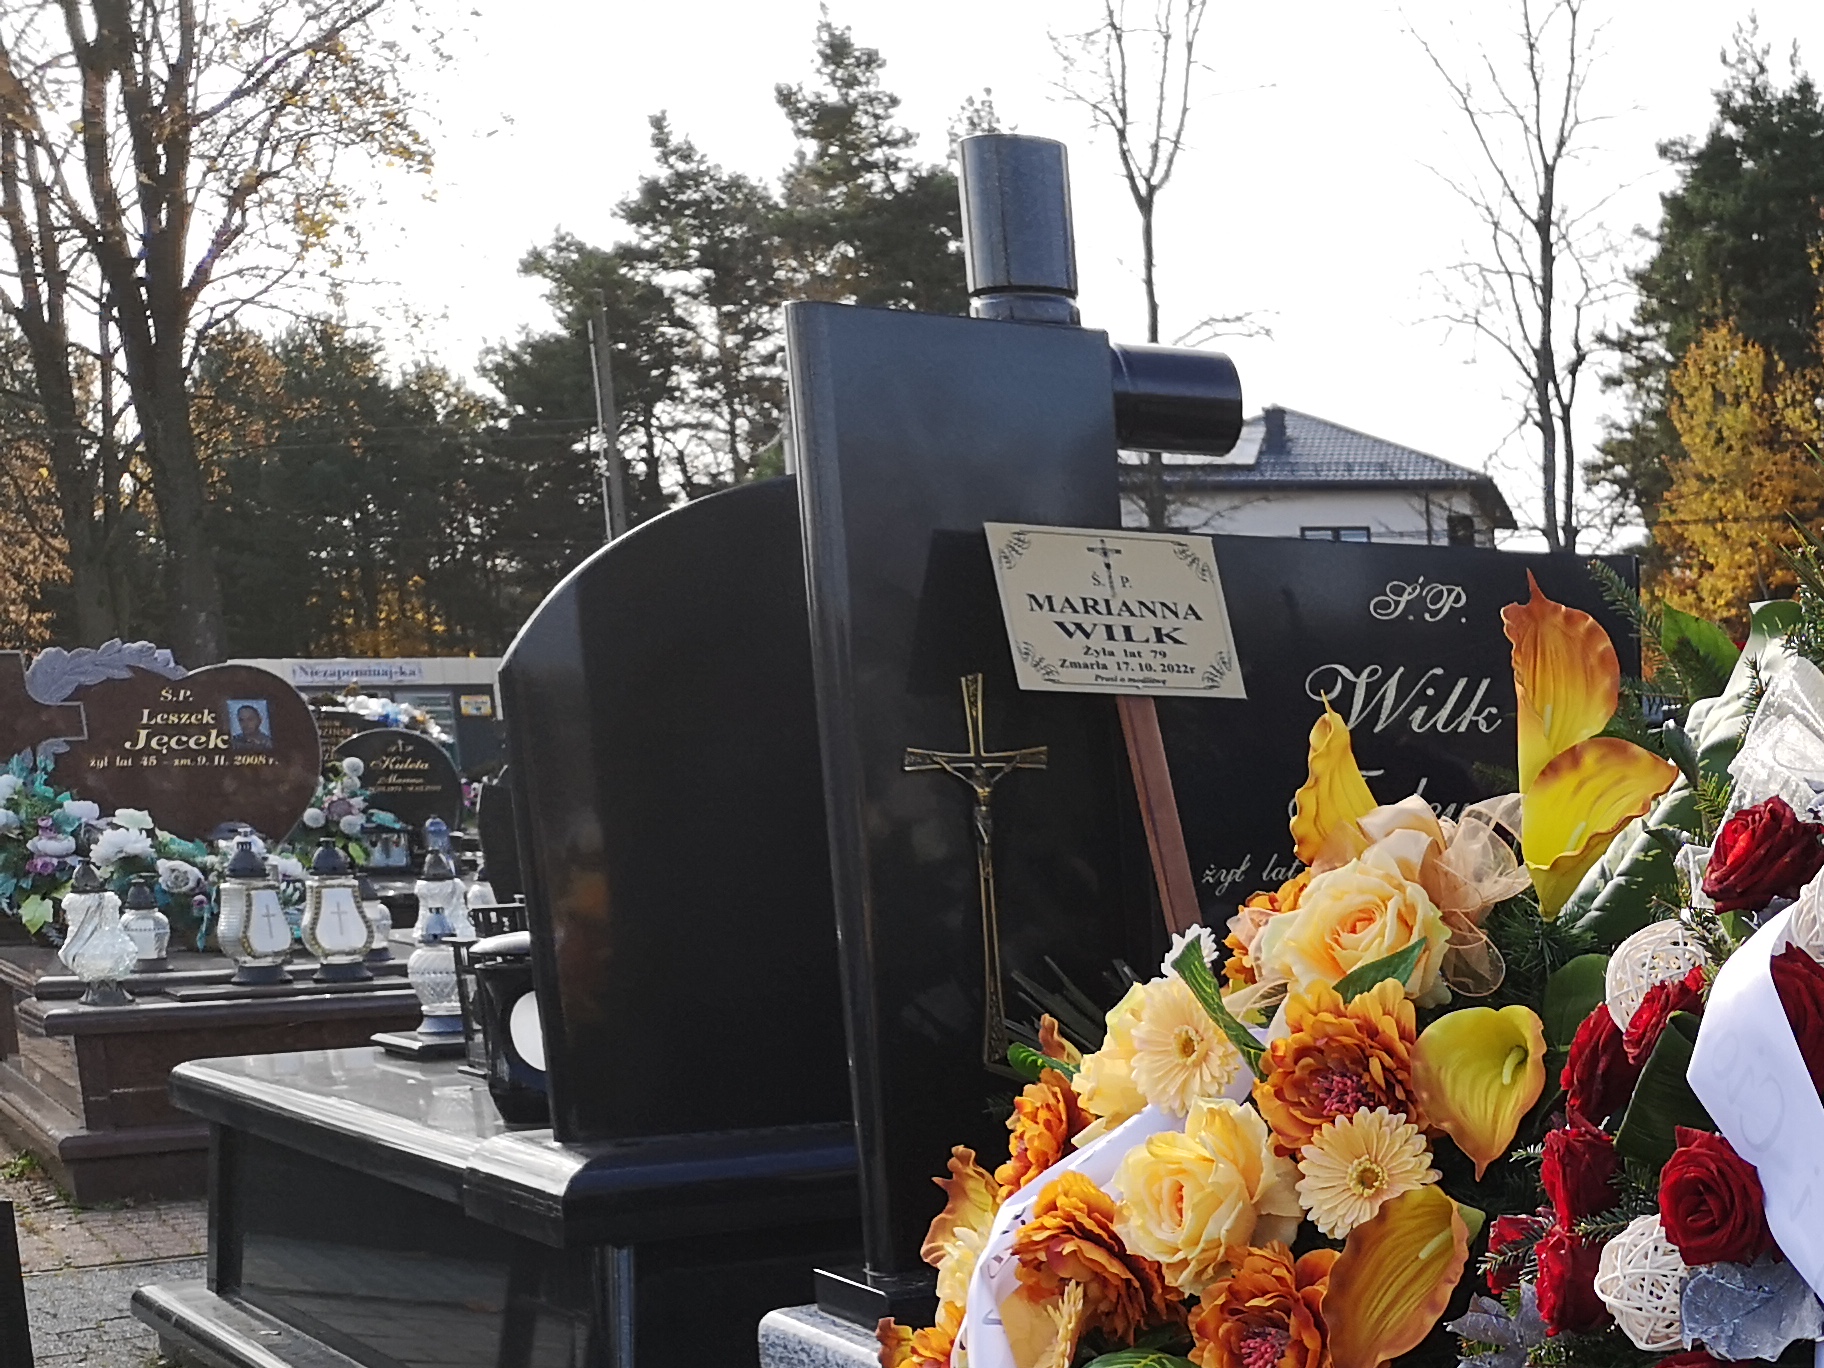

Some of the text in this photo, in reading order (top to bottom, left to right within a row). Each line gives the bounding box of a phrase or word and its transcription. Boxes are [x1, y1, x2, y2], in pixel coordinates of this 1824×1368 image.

[1120, 575, 1133, 589] P.
[1026, 593, 1203, 622] MARIANNA
[1053, 621, 1188, 645] WILK
[1124, 649, 1142, 658] lat
[1150, 650, 1167, 659] 79
[1304, 664, 1502, 734] Wilk
[139, 708, 216, 725] Leszek
[124, 729, 230, 754] Jęcek
[115, 755, 133, 767] lat
[1202, 853, 1302, 896] żył lat
